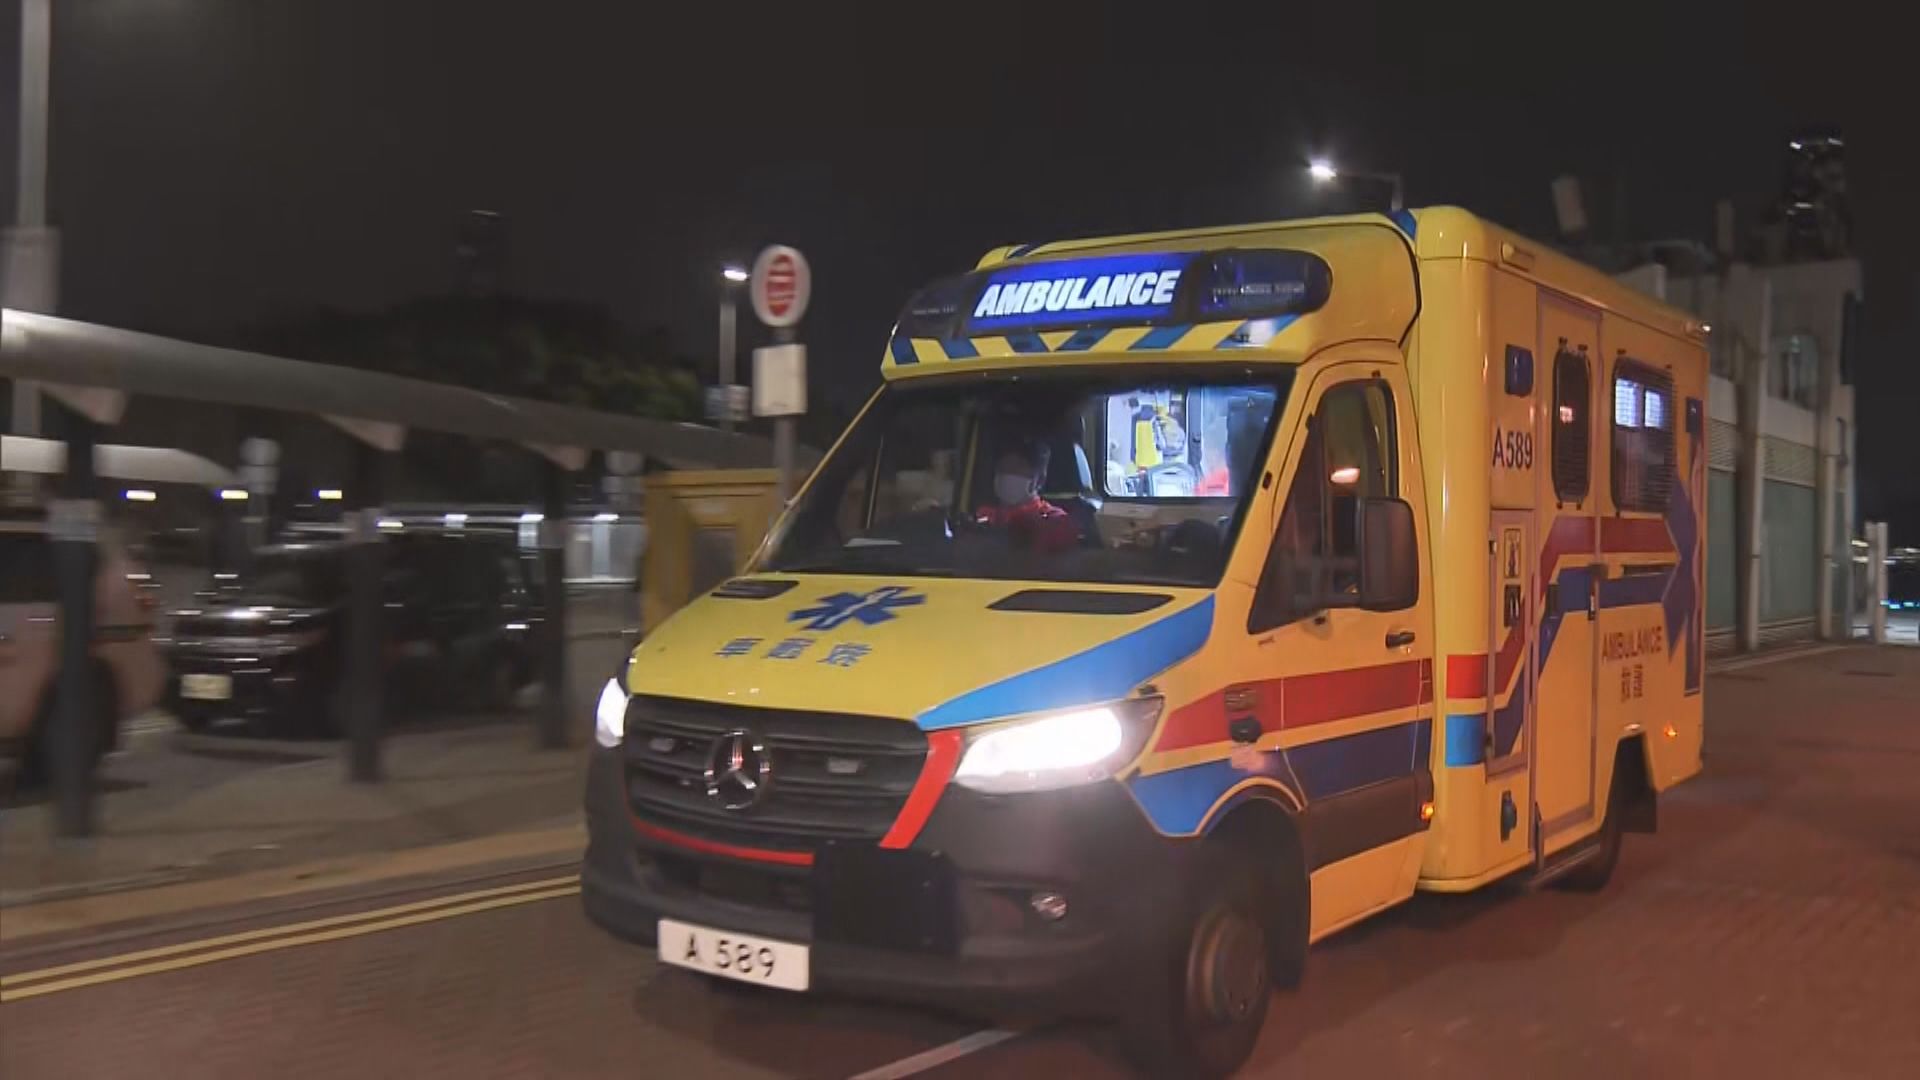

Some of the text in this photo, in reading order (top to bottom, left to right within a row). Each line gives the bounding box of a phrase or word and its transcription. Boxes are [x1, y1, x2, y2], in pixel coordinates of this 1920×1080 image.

[974, 270, 1181, 318] AMBULANCE
[1492, 429, 1533, 469] A589
[684, 933, 775, 978] A 589
